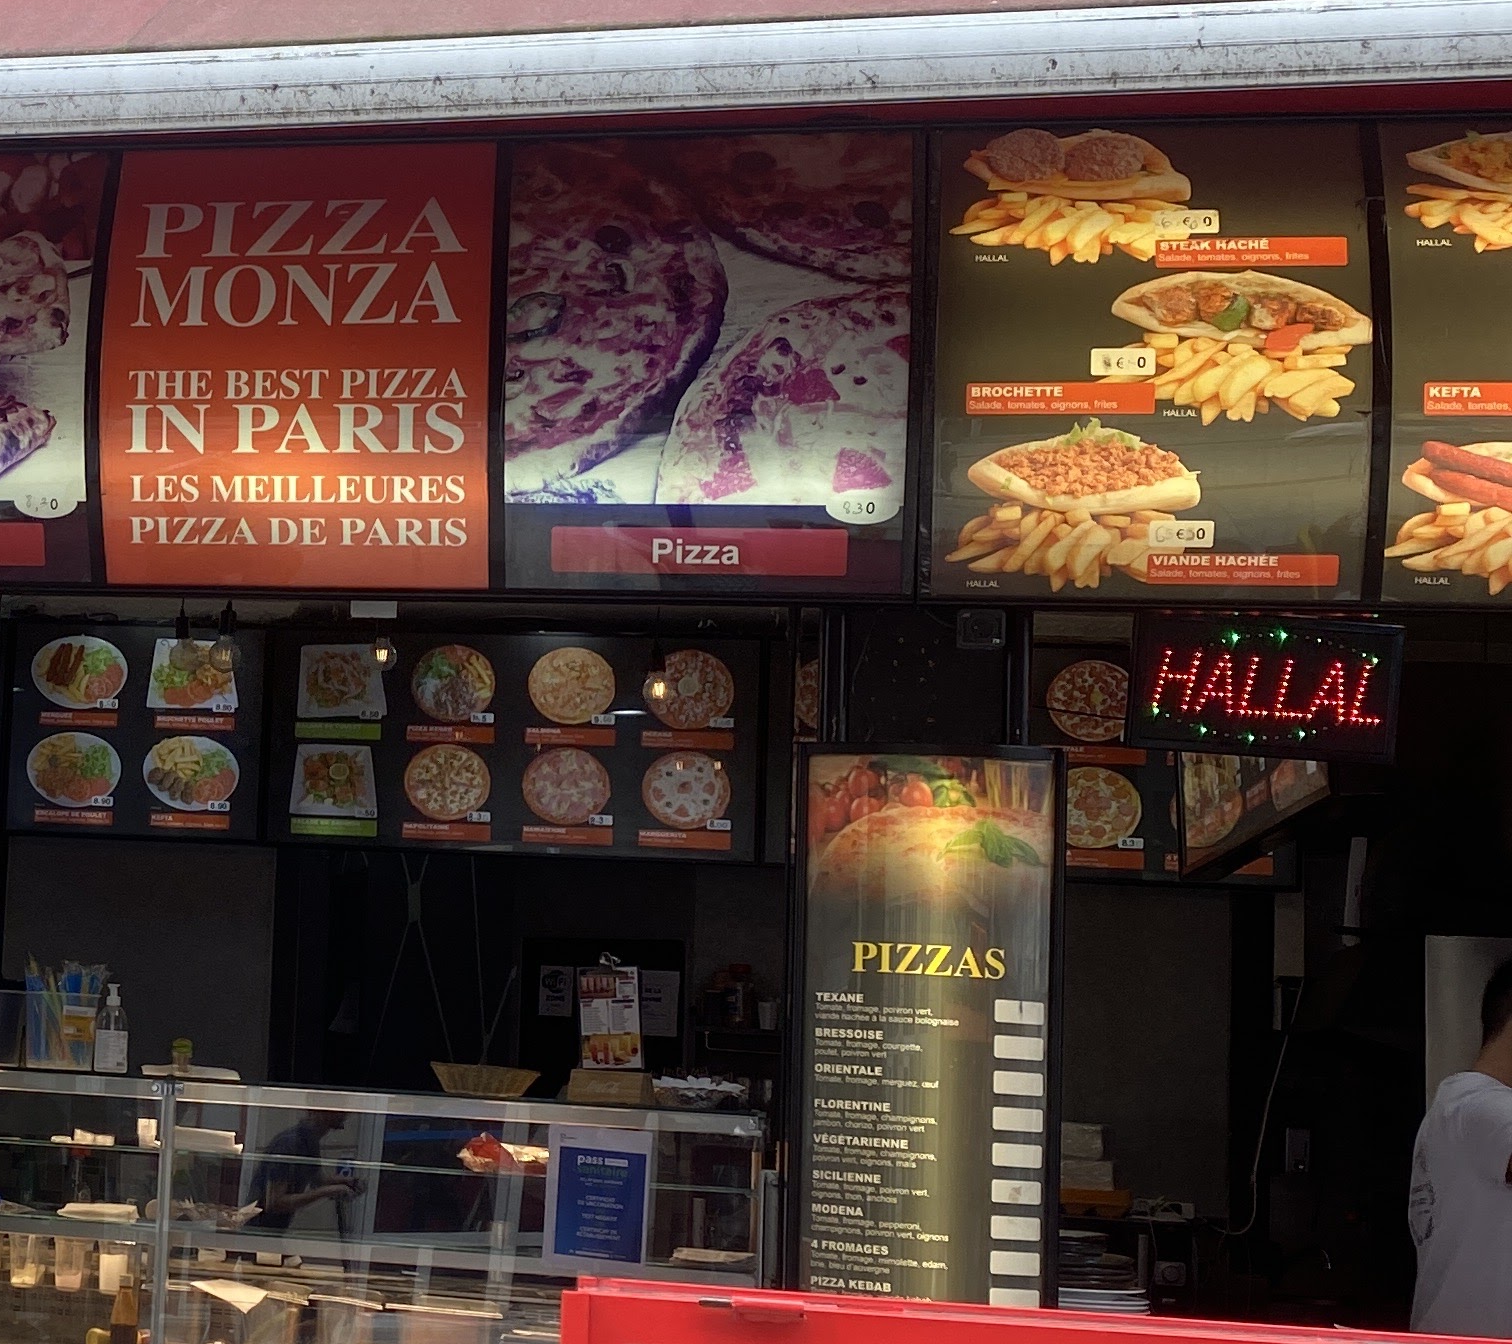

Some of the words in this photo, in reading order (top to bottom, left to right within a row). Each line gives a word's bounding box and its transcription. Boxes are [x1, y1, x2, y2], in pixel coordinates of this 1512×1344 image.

[136, 196, 468, 259] PIZZA
[1159, 240, 1211, 251] STEAK
[1215, 237, 1269, 250] HACHÉ
[1416, 238, 1452, 247] HALLAL
[974, 253, 1009, 263] HALLAL
[130, 261, 462, 327] MONZA
[129, 370, 213, 400] THE
[224, 369, 329, 399] BEST
[340, 368, 468, 399] PIZZA
[971, 386, 1064, 398] BROCHETTE
[1428, 386, 1481, 398] KEFTA
[969, 400, 1005, 410] Salade,
[1093, 399, 1118, 409] frites
[1162, 408, 1198, 417] HALLAL
[125, 404, 210, 454] IN
[232, 402, 466, 455] PARIS
[130, 474, 199, 503] LES
[211, 474, 466, 504] MEILLEURES
[129, 516, 259, 545] PIZZA
[269, 517, 328, 546] DE
[339, 517, 468, 547] PARIS
[652, 538, 740, 566] Pizza
[1152, 555, 1211, 567] VIANDE
[1215, 554, 1279, 567] HACHÉE
[1149, 568, 1186, 578] Salade,
[1276, 569, 1301, 579] frites
[1414, 576, 1451, 585] HALLAL
[965, 579, 1000, 588] HALLAL
[1150, 646, 1383, 725] HALLAL
[851, 941, 1007, 980] PIZZAS
[815, 992, 865, 1004] TEXANE
[915, 1016, 960, 1027] bolognaise
[814, 1027, 884, 1041] BRESSOISE
[814, 1063, 883, 1077] ORIENTALE
[814, 1098, 891, 1112] FLORENTINE
[813, 1132, 909, 1150] VÉGÉTARIENNE
[577, 1154, 604, 1167] pass
[812, 1170, 882, 1184] SICILIENNE
[811, 1203, 864, 1217] MODENA
[916, 1232, 950, 1243] oignons
[811, 1239, 819, 1249] 4
[821, 1240, 889, 1256] FROMAGES
[810, 1275, 846, 1288] PIZZA
[848, 1279, 892, 1293] KEBAB
